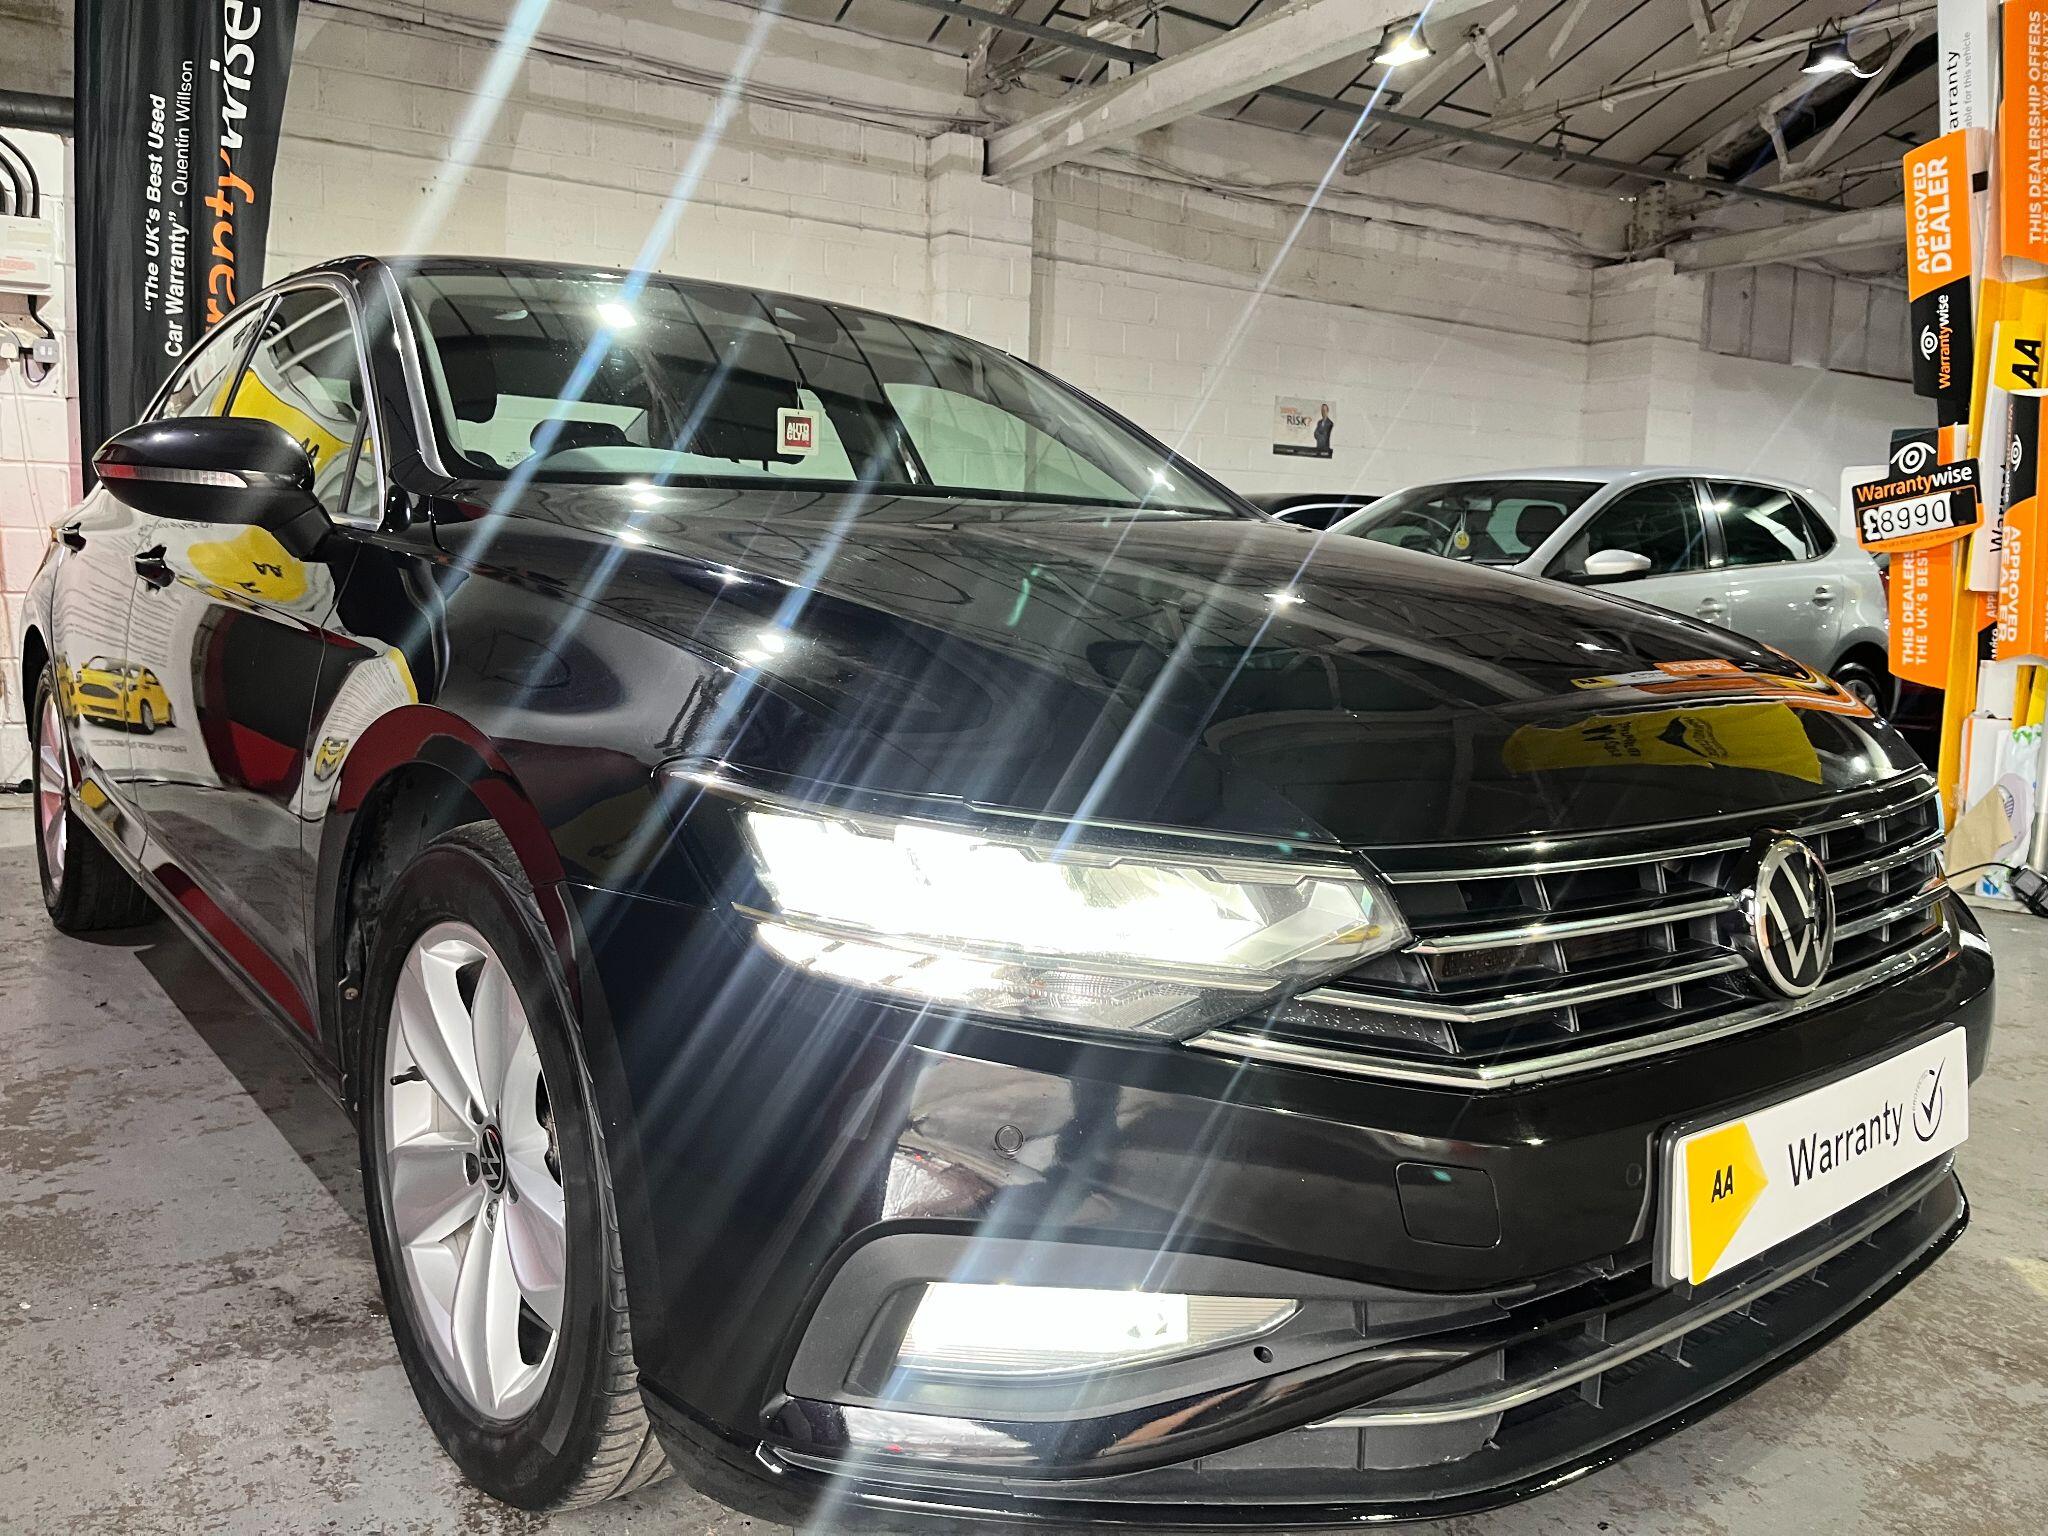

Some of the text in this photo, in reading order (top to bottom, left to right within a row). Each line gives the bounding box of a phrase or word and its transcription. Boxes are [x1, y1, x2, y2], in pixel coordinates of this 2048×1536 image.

[1963, 32, 1972, 67] vehicle
[175, 60, 193, 125] Willson
[1946, 52, 1961, 133] arranty
[1963, 69, 1972, 89] this
[1964, 90, 1972, 104] for
[148, 94, 166, 150] Used
[2028, 11, 2042, 244] THIS DEALERSHIP OFFERS
[146, 152, 163, 203] Best
[172, 129, 191, 196] Quentin
[204, 0, 262, 325] rantywise
[1913, 161, 1930, 275] APPROVED
[1927, 156, 1952, 275] DEALER
[164, 320, 183, 357] Car
[1936, 294, 1953, 390] Warrantywise
[2011, 338, 2042, 389] AA
[787, 422, 809, 433] AUTO
[1856, 466, 1973, 503] Warrantywise
[1863, 499, 1947, 541] £8990
[2007, 526, 2021, 642] APPROVED
[1916, 592, 1928, 629] UK'S
[1902, 626, 1915, 665] THIS
[1916, 635, 1928, 665] THE
[1788, 1100, 1904, 1187] Warranty
[1711, 1164, 1734, 1203] AA
